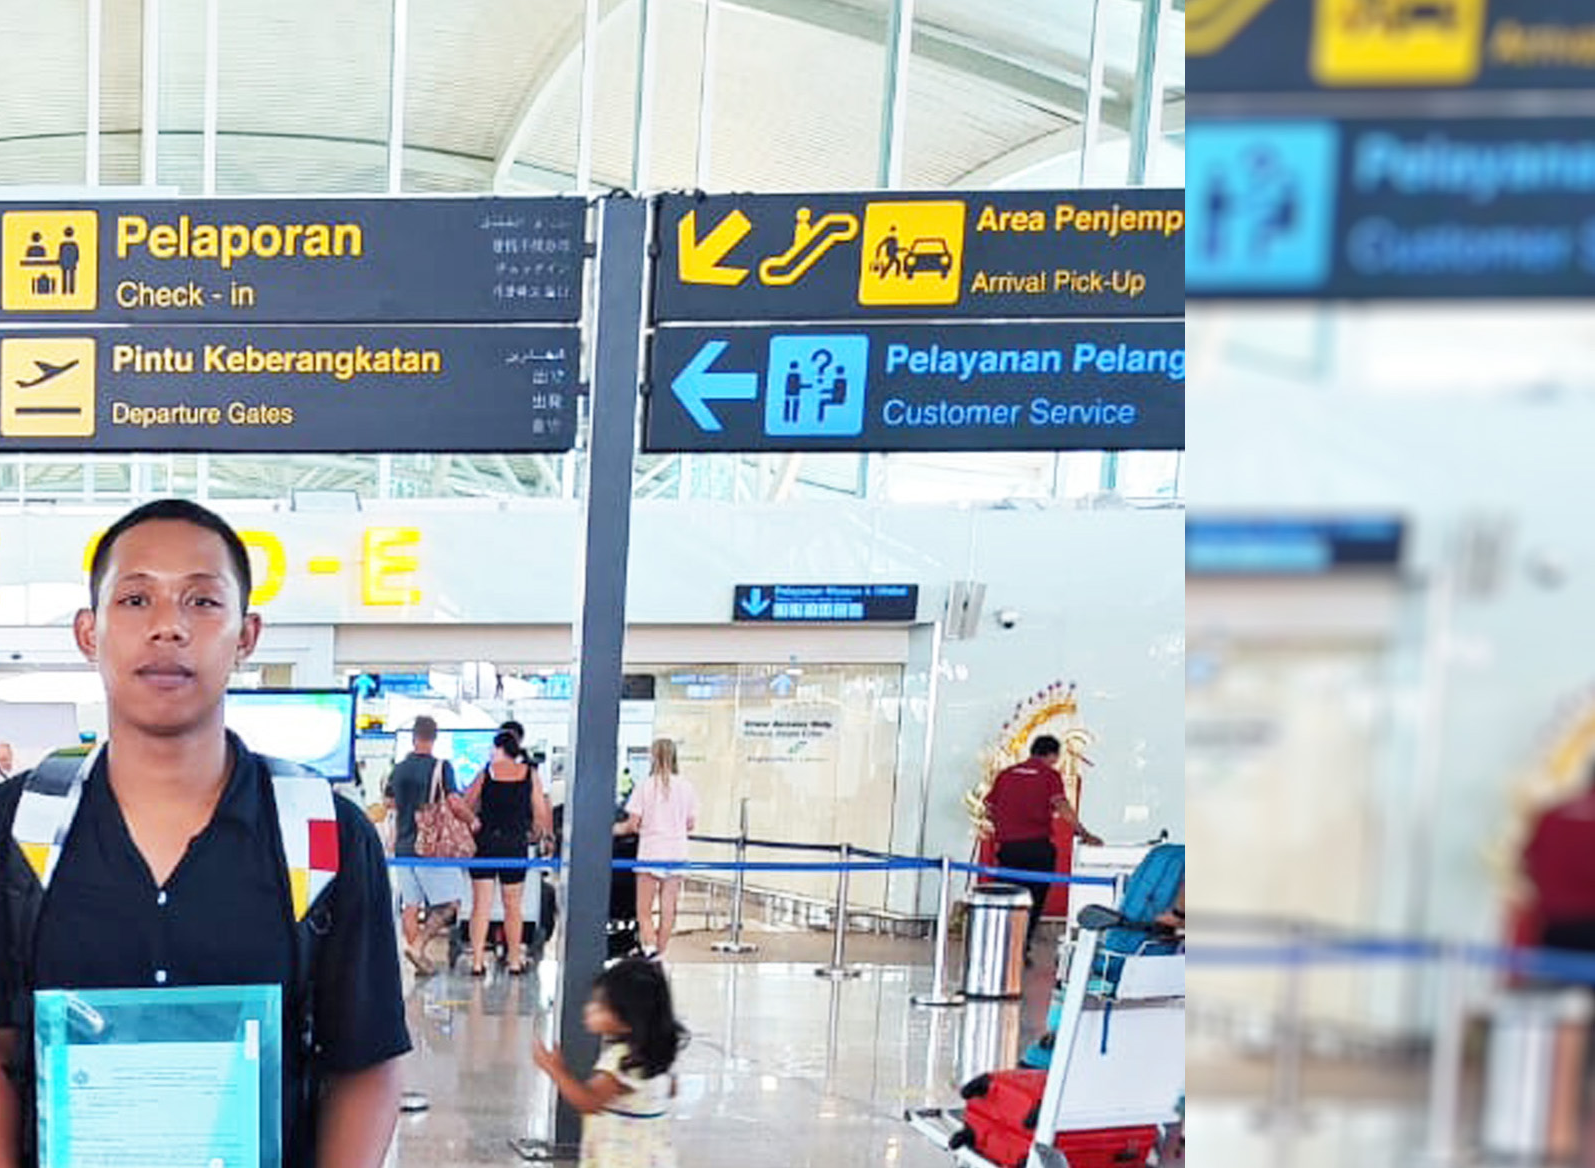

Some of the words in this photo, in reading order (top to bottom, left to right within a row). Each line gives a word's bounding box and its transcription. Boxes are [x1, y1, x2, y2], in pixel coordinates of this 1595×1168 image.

[976, 206, 1046, 232] Area
[1054, 203, 1185, 238] Penjemp
[116, 214, 363, 269] Pelaporan
[116, 281, 205, 308] Check
[231, 281, 254, 307] in
[970, 271, 1047, 294] Arrival
[1053, 269, 1146, 299] Pick-Up
[112, 344, 194, 373] Pintu
[203, 345, 442, 381] Keberangkatan
[885, 344, 1062, 381] Pelayanan
[1072, 342, 1185, 381] Pelang
[112, 401, 222, 428] Departure
[227, 401, 294, 425] Gates
[882, 399, 1022, 426] Customer
[1028, 397, 1137, 425] Service
[362, 526, 422, 607] E
